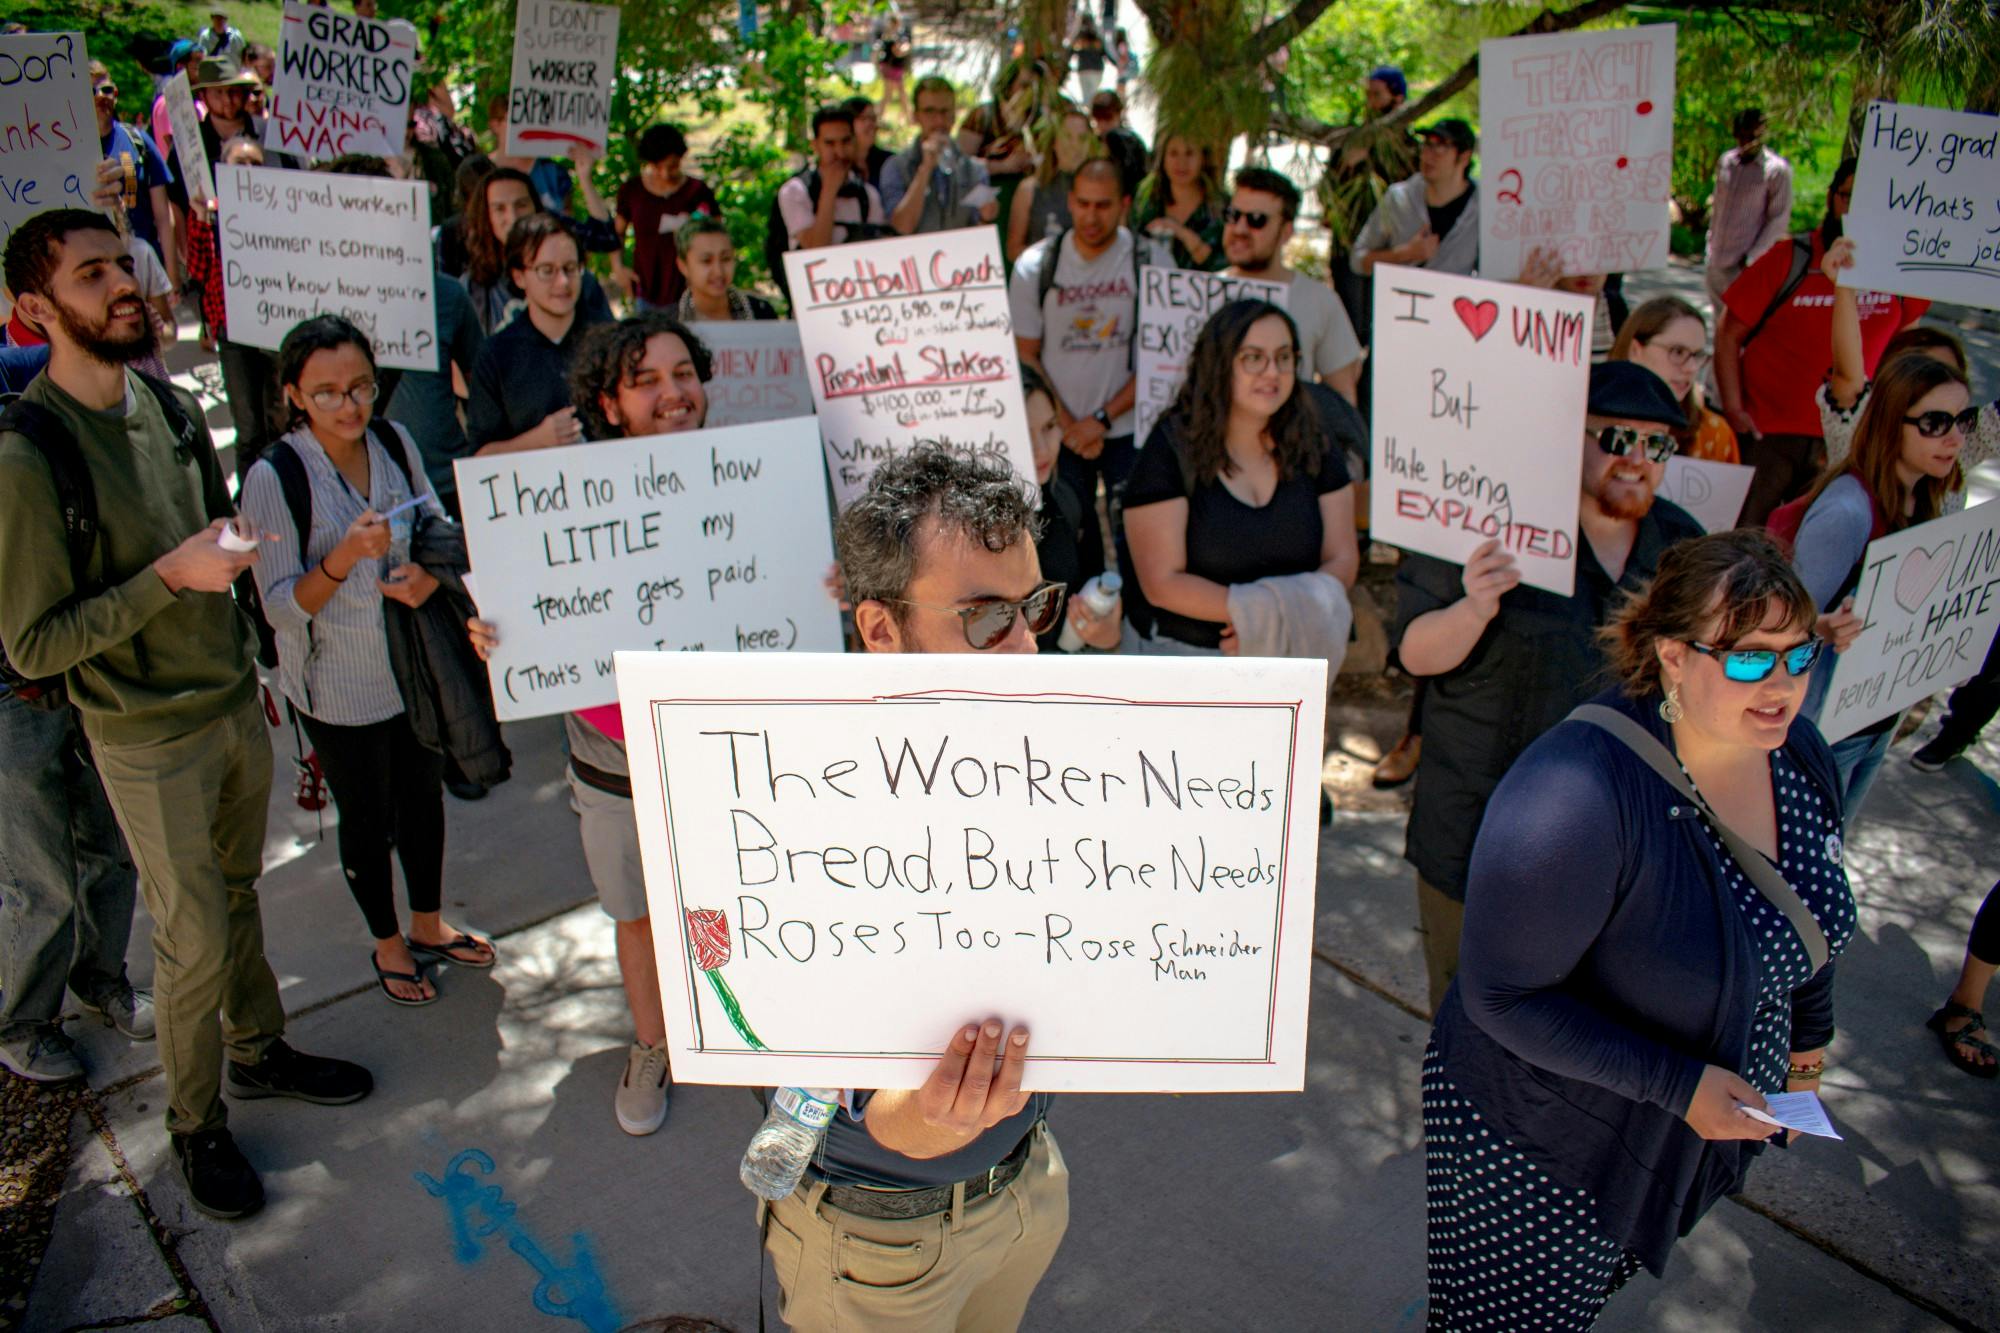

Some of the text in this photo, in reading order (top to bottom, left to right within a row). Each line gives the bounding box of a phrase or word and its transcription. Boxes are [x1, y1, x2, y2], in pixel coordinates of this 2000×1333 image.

[308, 12, 390, 52] GRAD
[283, 39, 409, 105] WORKERS
[529, 58, 599, 89] WORKER
[1936, 130, 1998, 174] grad
[236, 169, 418, 222] Hey, grad worker!
[1497, 168, 1523, 206] 2
[1888, 178, 1974, 221] What's
[225, 213, 311, 251] Summer
[319, 240, 337, 257] is
[1902, 229, 1951, 258] Side
[226, 259, 252, 290] Do
[254, 276, 283, 296] you
[337, 277, 372, 298] how
[803, 257, 923, 304] Football
[256, 299, 307, 326] going
[1391, 286, 1585, 369] I UNM
[816, 352, 907, 398] President
[1431, 367, 1479, 430] But
[829, 437, 901, 463] What
[480, 446, 762, 522] I had no idea how
[1384, 436, 1513, 528] Hate being
[543, 511, 735, 568] LITTLE my
[1395, 488, 1574, 561] EXPLOITED
[532, 554, 767, 626] teacher gets paid.
[1862, 527, 2000, 631] I UN
[735, 618, 798, 652] here.)
[1881, 577, 2000, 657] but HATE
[504, 662, 581, 703] (That's
[1887, 626, 1974, 702] POOR
[699, 730, 1274, 811] The Worker Needs
[730, 808, 1276, 895] Bread, But She Needs
[738, 895, 907, 963] Roses
[917, 910, 1001, 952] Too
[1044, 912, 1135, 963] Rose
[1149, 922, 1262, 964] Schneider
[1154, 960, 1207, 984] Man
